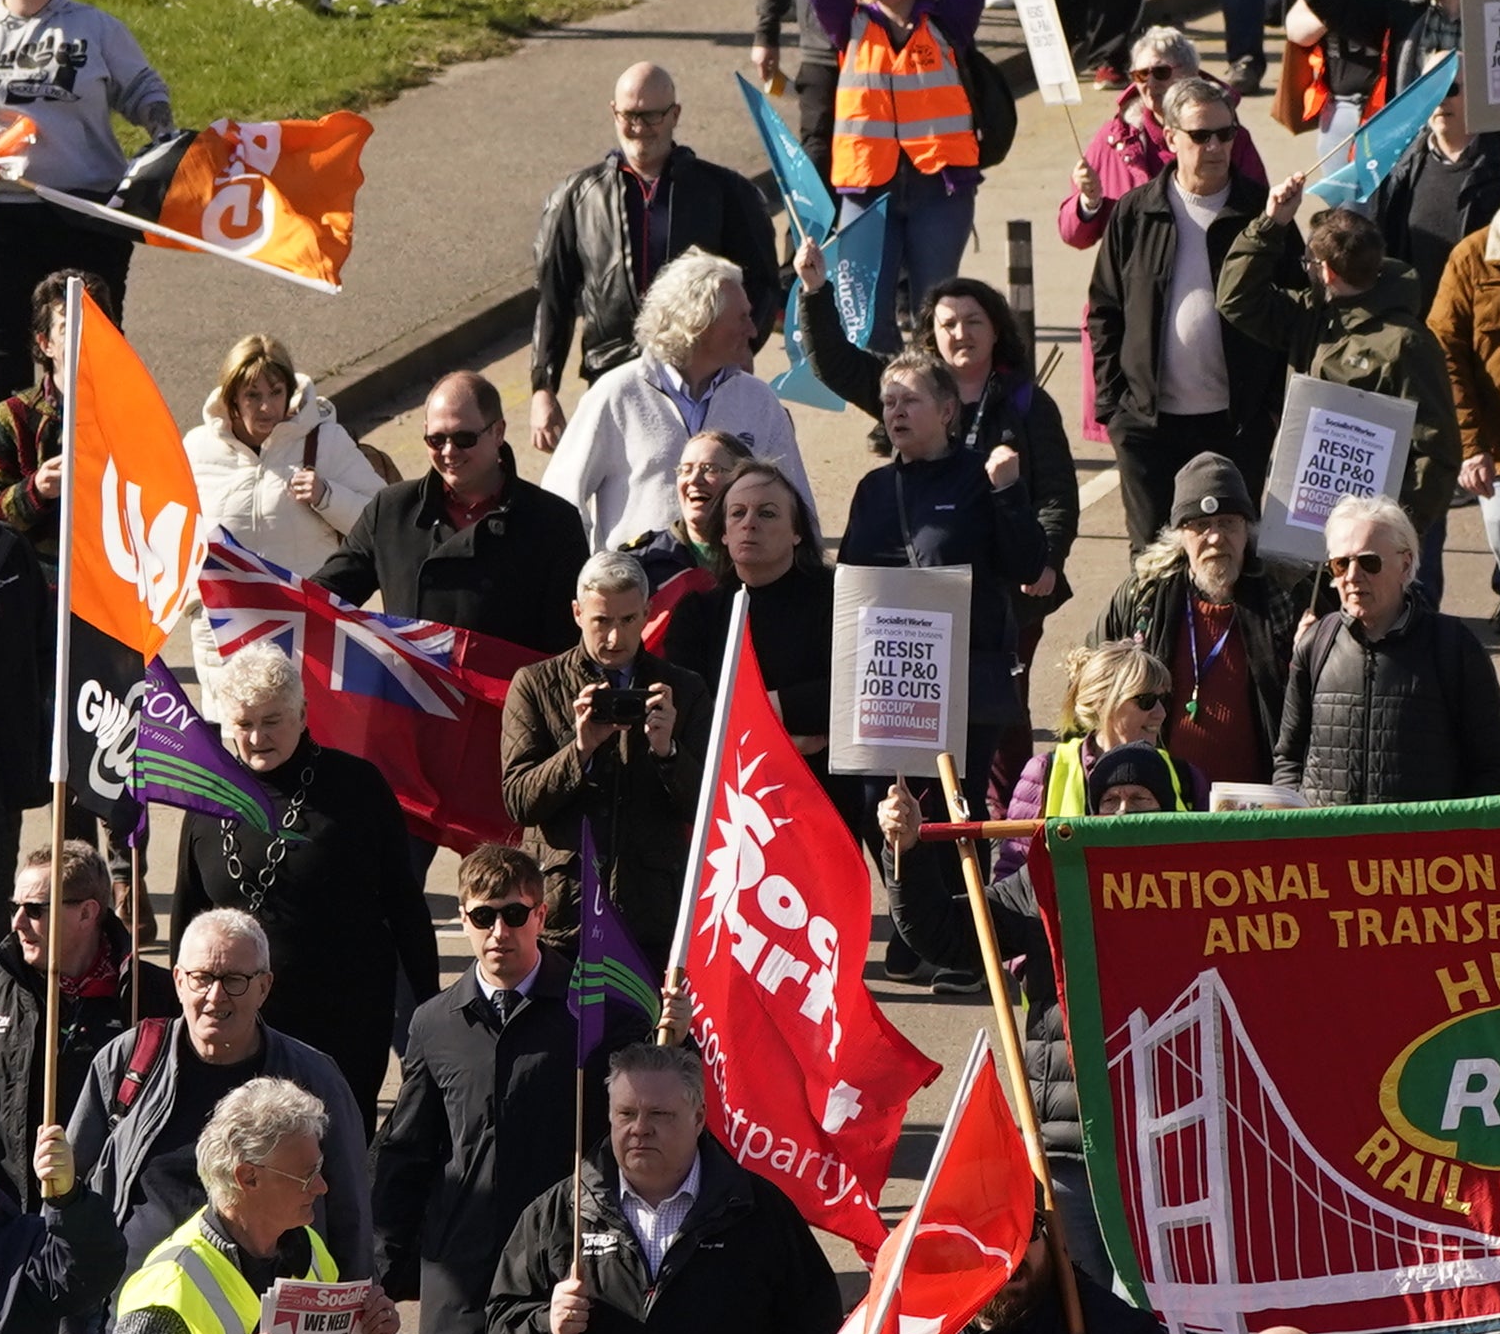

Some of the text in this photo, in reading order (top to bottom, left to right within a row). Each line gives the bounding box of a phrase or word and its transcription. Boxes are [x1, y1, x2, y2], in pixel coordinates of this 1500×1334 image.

[838, 259, 860, 344] educatio
[1319, 438, 1375, 466] RESIST
[1308, 454, 1375, 484] ALL P&O
[1300, 471, 1375, 500] JOB CUTS
[1308, 490, 1339, 507] OCCU
[876, 616, 933, 628] Socialist Worker
[904, 629, 916, 638] the
[874, 640, 934, 660] RESIST
[866, 660, 938, 680] ALL P&O
[860, 679, 941, 700] JOB CUTS
[872, 701, 915, 714] OCCUPY
[870, 714, 937, 730] NATIONALISE
[1103, 863, 1329, 910] NATIONAL
[1348, 853, 1497, 896] UNION
[1203, 912, 1300, 956] AND
[1354, 1125, 1472, 1216] RAIL
[303, 1311, 351, 1331] WE NEED
